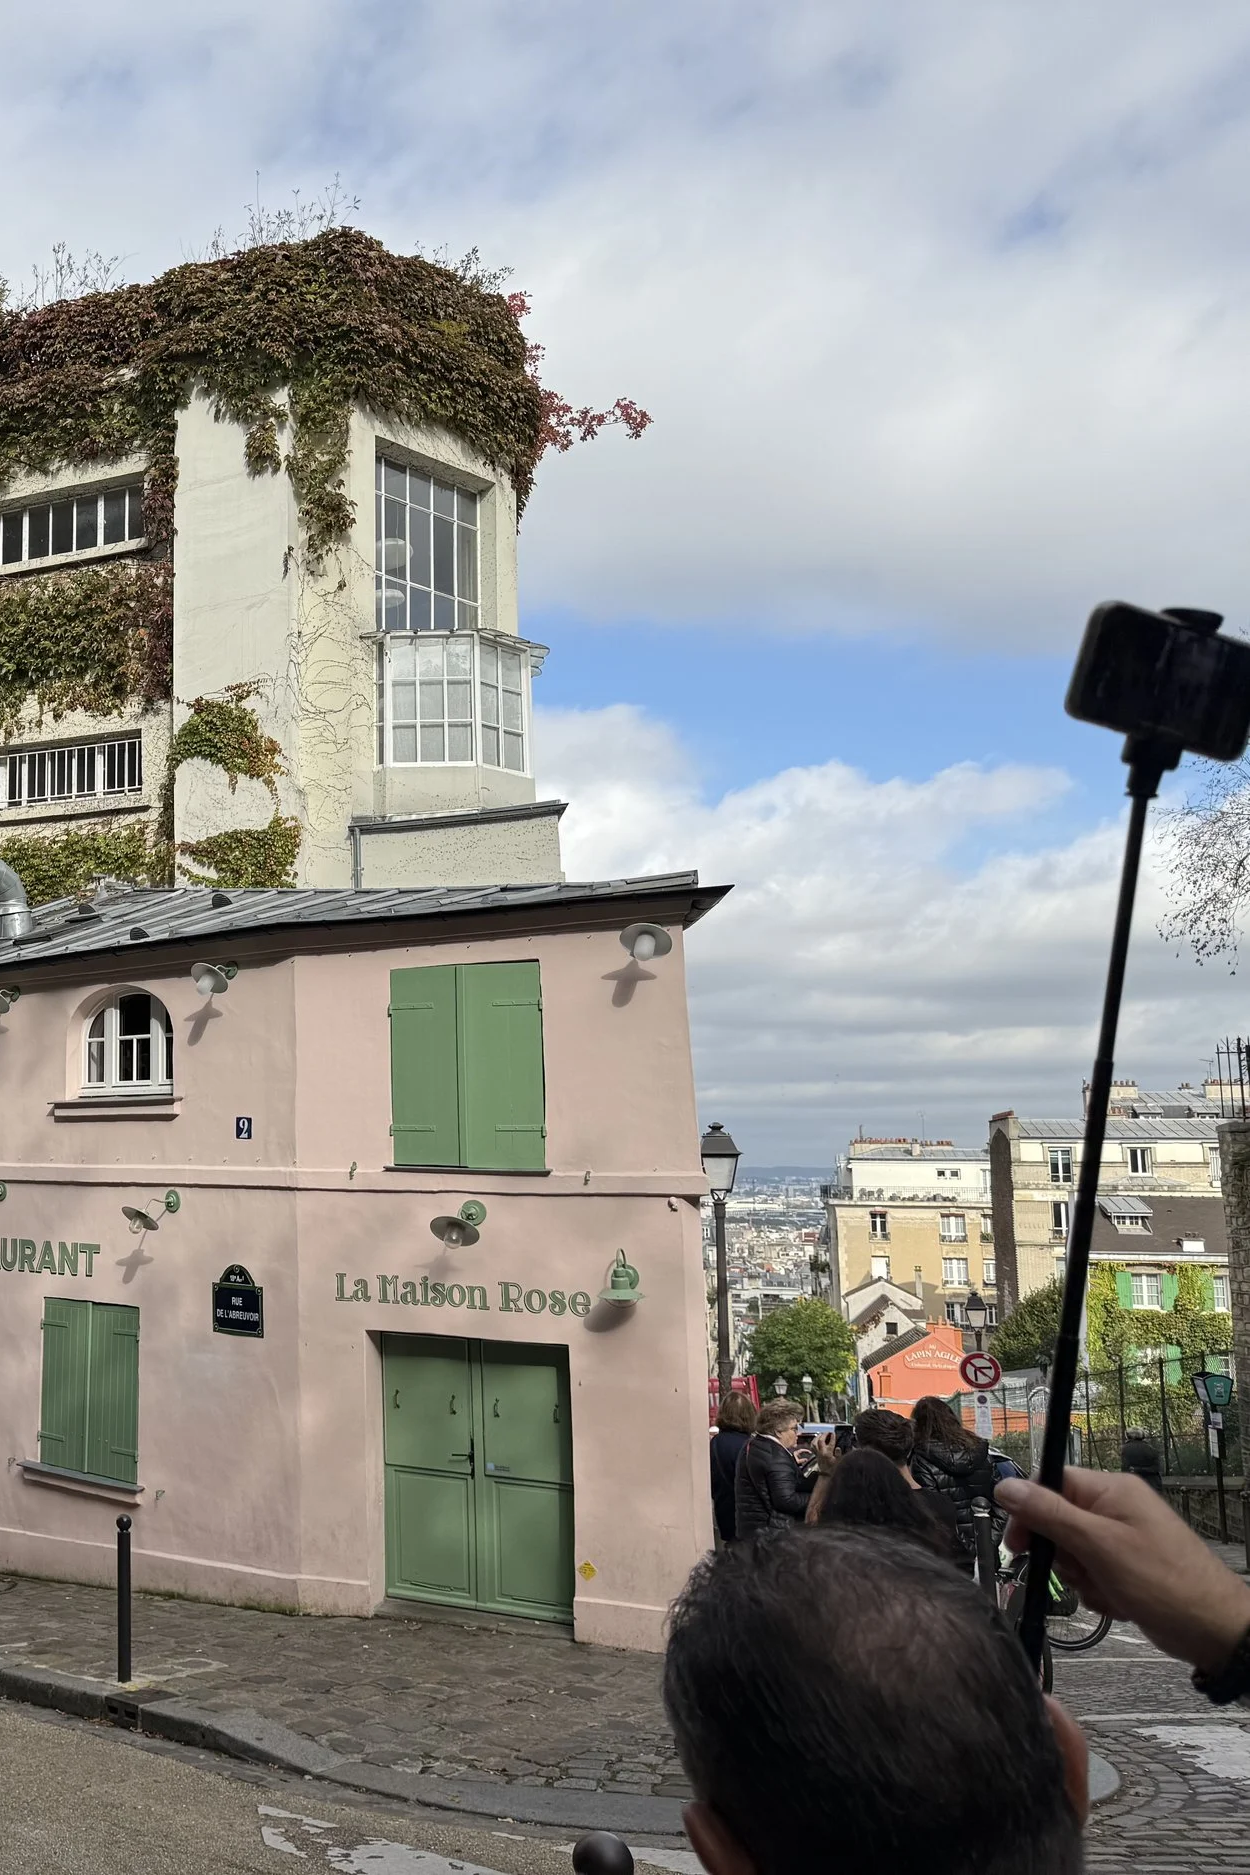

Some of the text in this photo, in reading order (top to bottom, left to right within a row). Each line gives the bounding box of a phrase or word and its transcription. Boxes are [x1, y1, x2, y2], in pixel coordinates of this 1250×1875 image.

[239, 1118, 249, 1139] 2
[231, 1296, 243, 1306] RUE
[335, 1272, 592, 1318] La Maison Rose
[216, 1308, 260, 1321] DE L'ABREUVOIR
[904, 1350, 962, 1363] LAPIN AGILE
